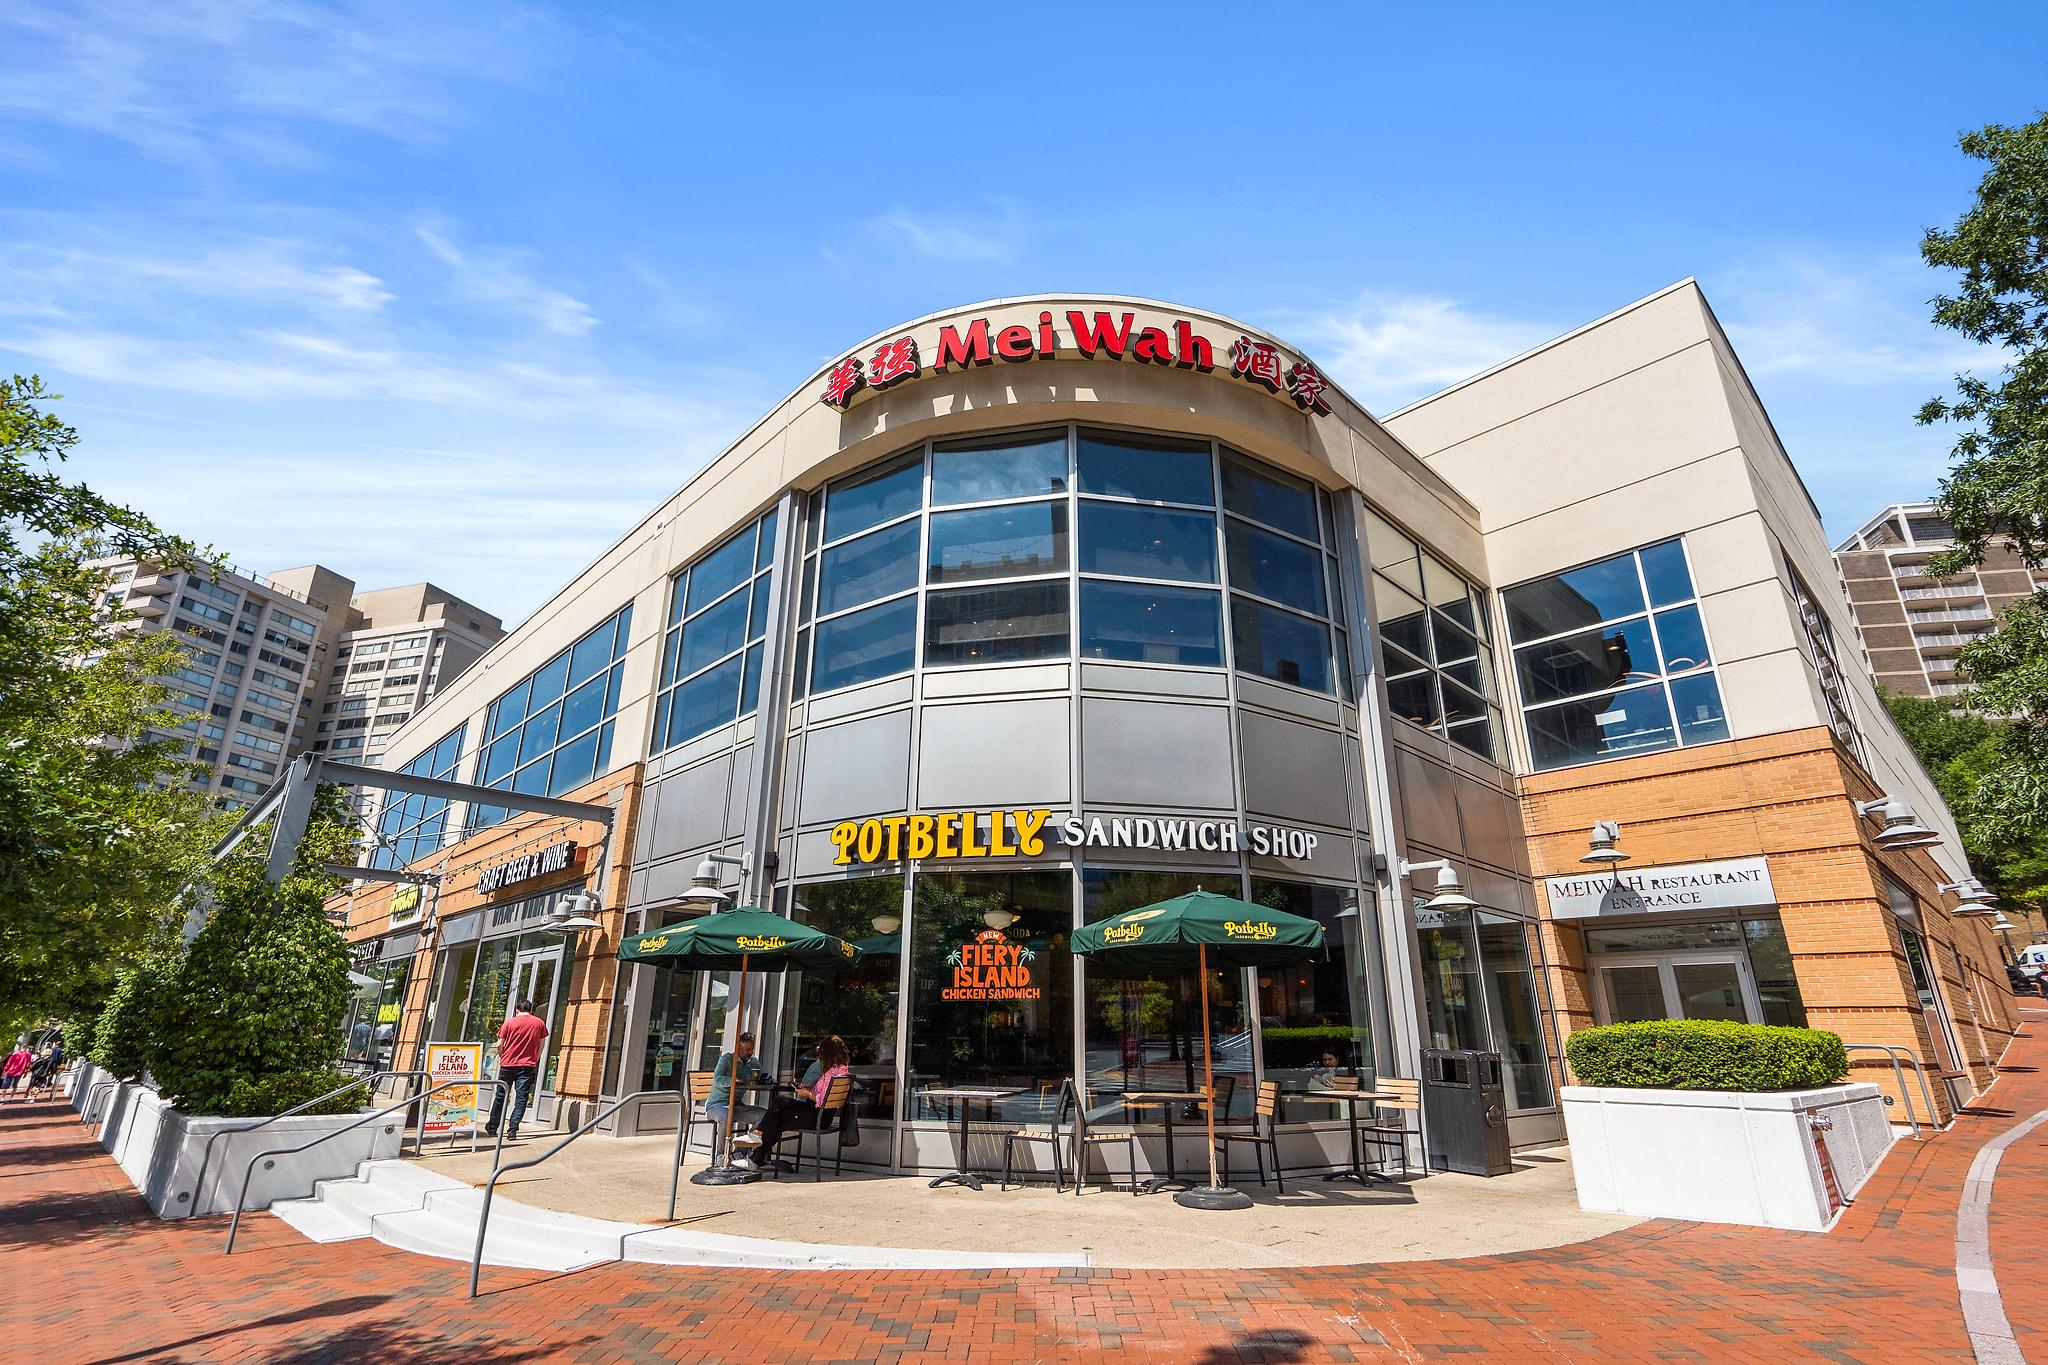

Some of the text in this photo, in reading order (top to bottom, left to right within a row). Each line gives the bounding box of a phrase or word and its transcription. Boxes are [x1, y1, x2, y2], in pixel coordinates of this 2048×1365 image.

[1229, 335, 1333, 417] 酒家
[831, 809, 1318, 866] POTBELLY SANDWICH SHOP
[478, 840, 570, 895] CRAFT BEER & WINE
[1552, 869, 1762, 898] MEIWAH RESTAURANT
[1612, 891, 1702, 910] ENTRANCE
[983, 931, 1000, 939] NEW
[1104, 923, 1145, 943] Potbelly
[1224, 919, 1277, 940] Potbelly
[962, 944, 1022, 966] FIERY
[954, 966, 1031, 988] ISLAND
[942, 987, 1040, 999] CHICKEN SANDWICH
[438, 1063, 468, 1071] ISLAND
[442, 1055, 466, 1064] FIERY
